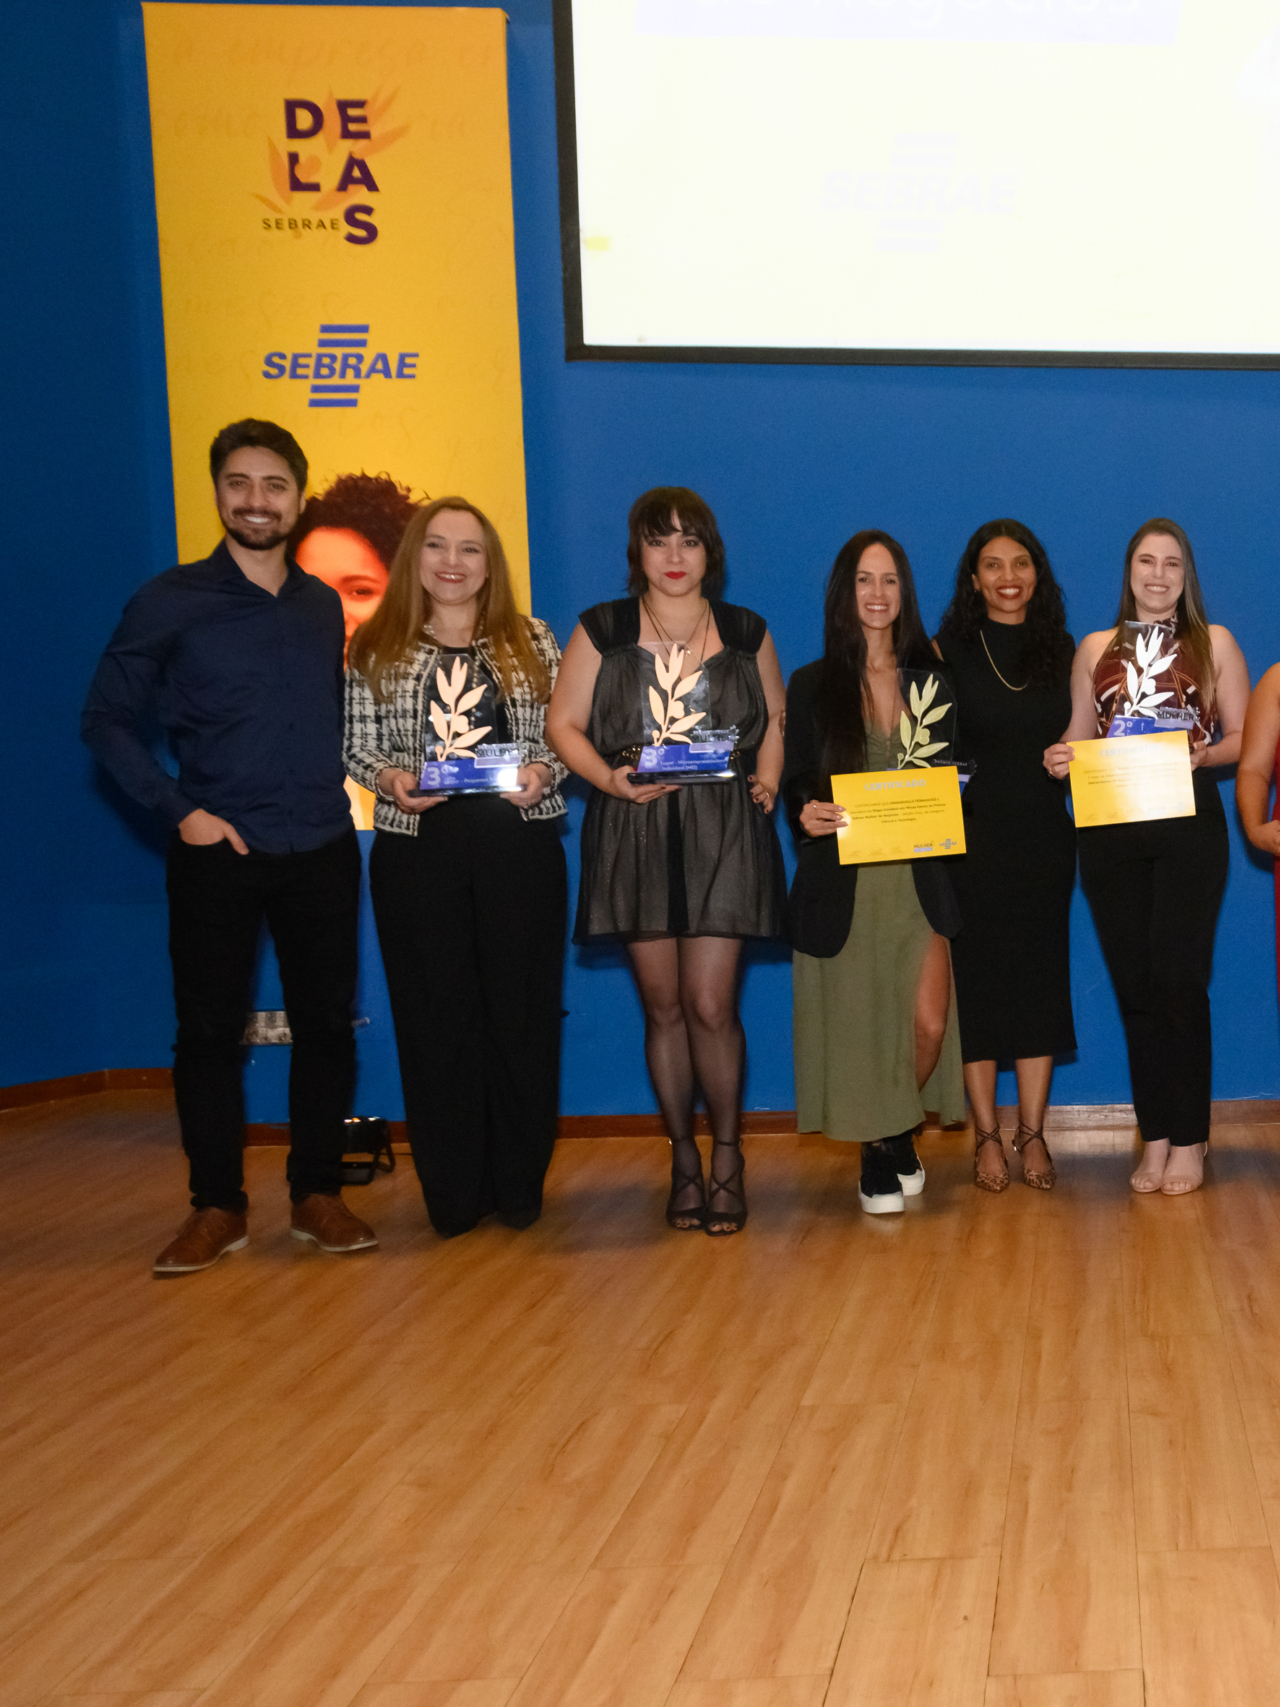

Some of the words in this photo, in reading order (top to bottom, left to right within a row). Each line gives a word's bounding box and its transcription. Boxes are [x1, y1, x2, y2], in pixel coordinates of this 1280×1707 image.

[821, 170, 1018, 214] SEBRAE
[262, 217, 340, 231] SEBRAE
[261, 351, 420, 380] SEBRAE
[864, 779, 926, 791] CERTIFICADO
